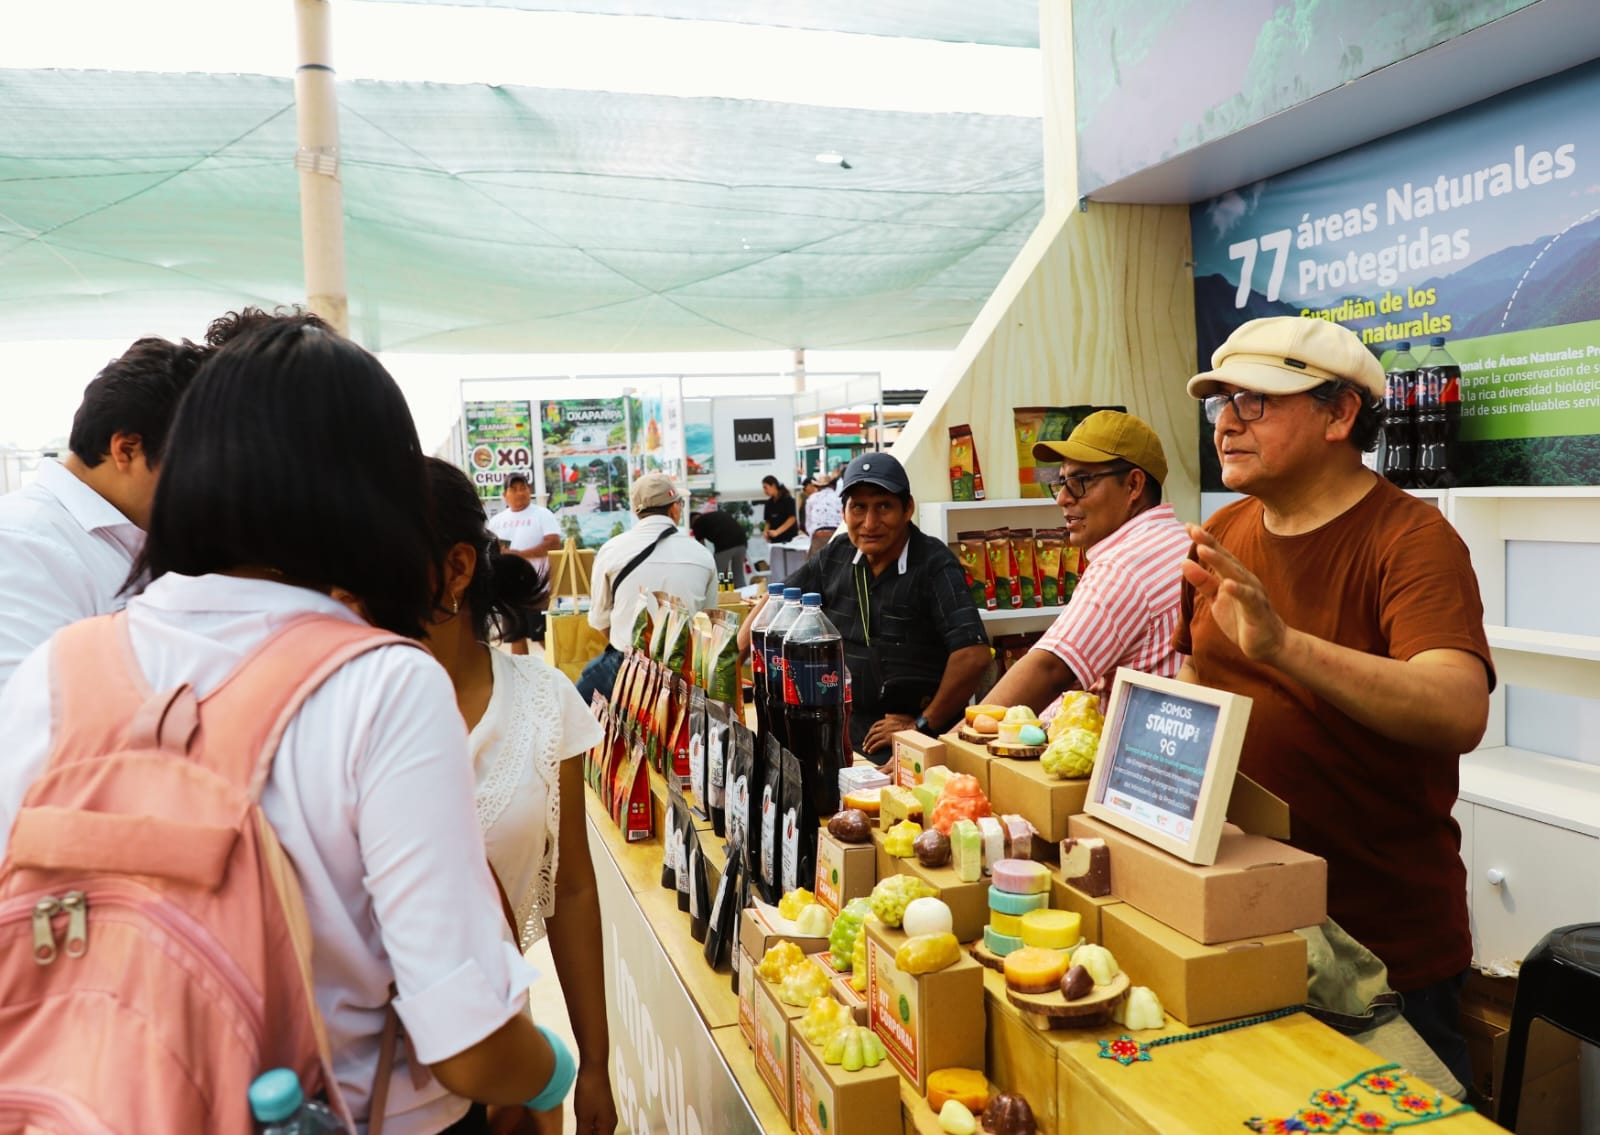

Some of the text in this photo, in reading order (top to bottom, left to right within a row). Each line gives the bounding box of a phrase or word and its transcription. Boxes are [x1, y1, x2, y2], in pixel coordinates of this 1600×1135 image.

[1296, 143, 1577, 250] áreas Naturales
[1229, 228, 1292, 310] 77
[1299, 226, 1472, 296] Protegidas
[1379, 290, 1403, 314] de
[1407, 285, 1437, 309] los
[1362, 312, 1452, 345] naturales
[1484, 358, 1497, 369] de
[1499, 354, 1528, 368] Áreas
[1530, 347, 1584, 364] Naturales
[1473, 375, 1489, 388] por
[1491, 371, 1501, 384] la
[1503, 364, 1573, 383] conservación
[1576, 362, 1591, 375] de
[1467, 390, 1476, 402] la
[1478, 389, 1496, 401] rica
[1499, 381, 1552, 399] diversidad
[1478, 404, 1489, 416] de
[1492, 404, 1508, 415] sus
[1509, 398, 1570, 414] invaluables
[738, 433, 772, 444] MADLA
[1160, 701, 1192, 720] SOMOS
[1146, 713, 1195, 742] STARTUP
[1160, 738, 1176, 756] 9G
